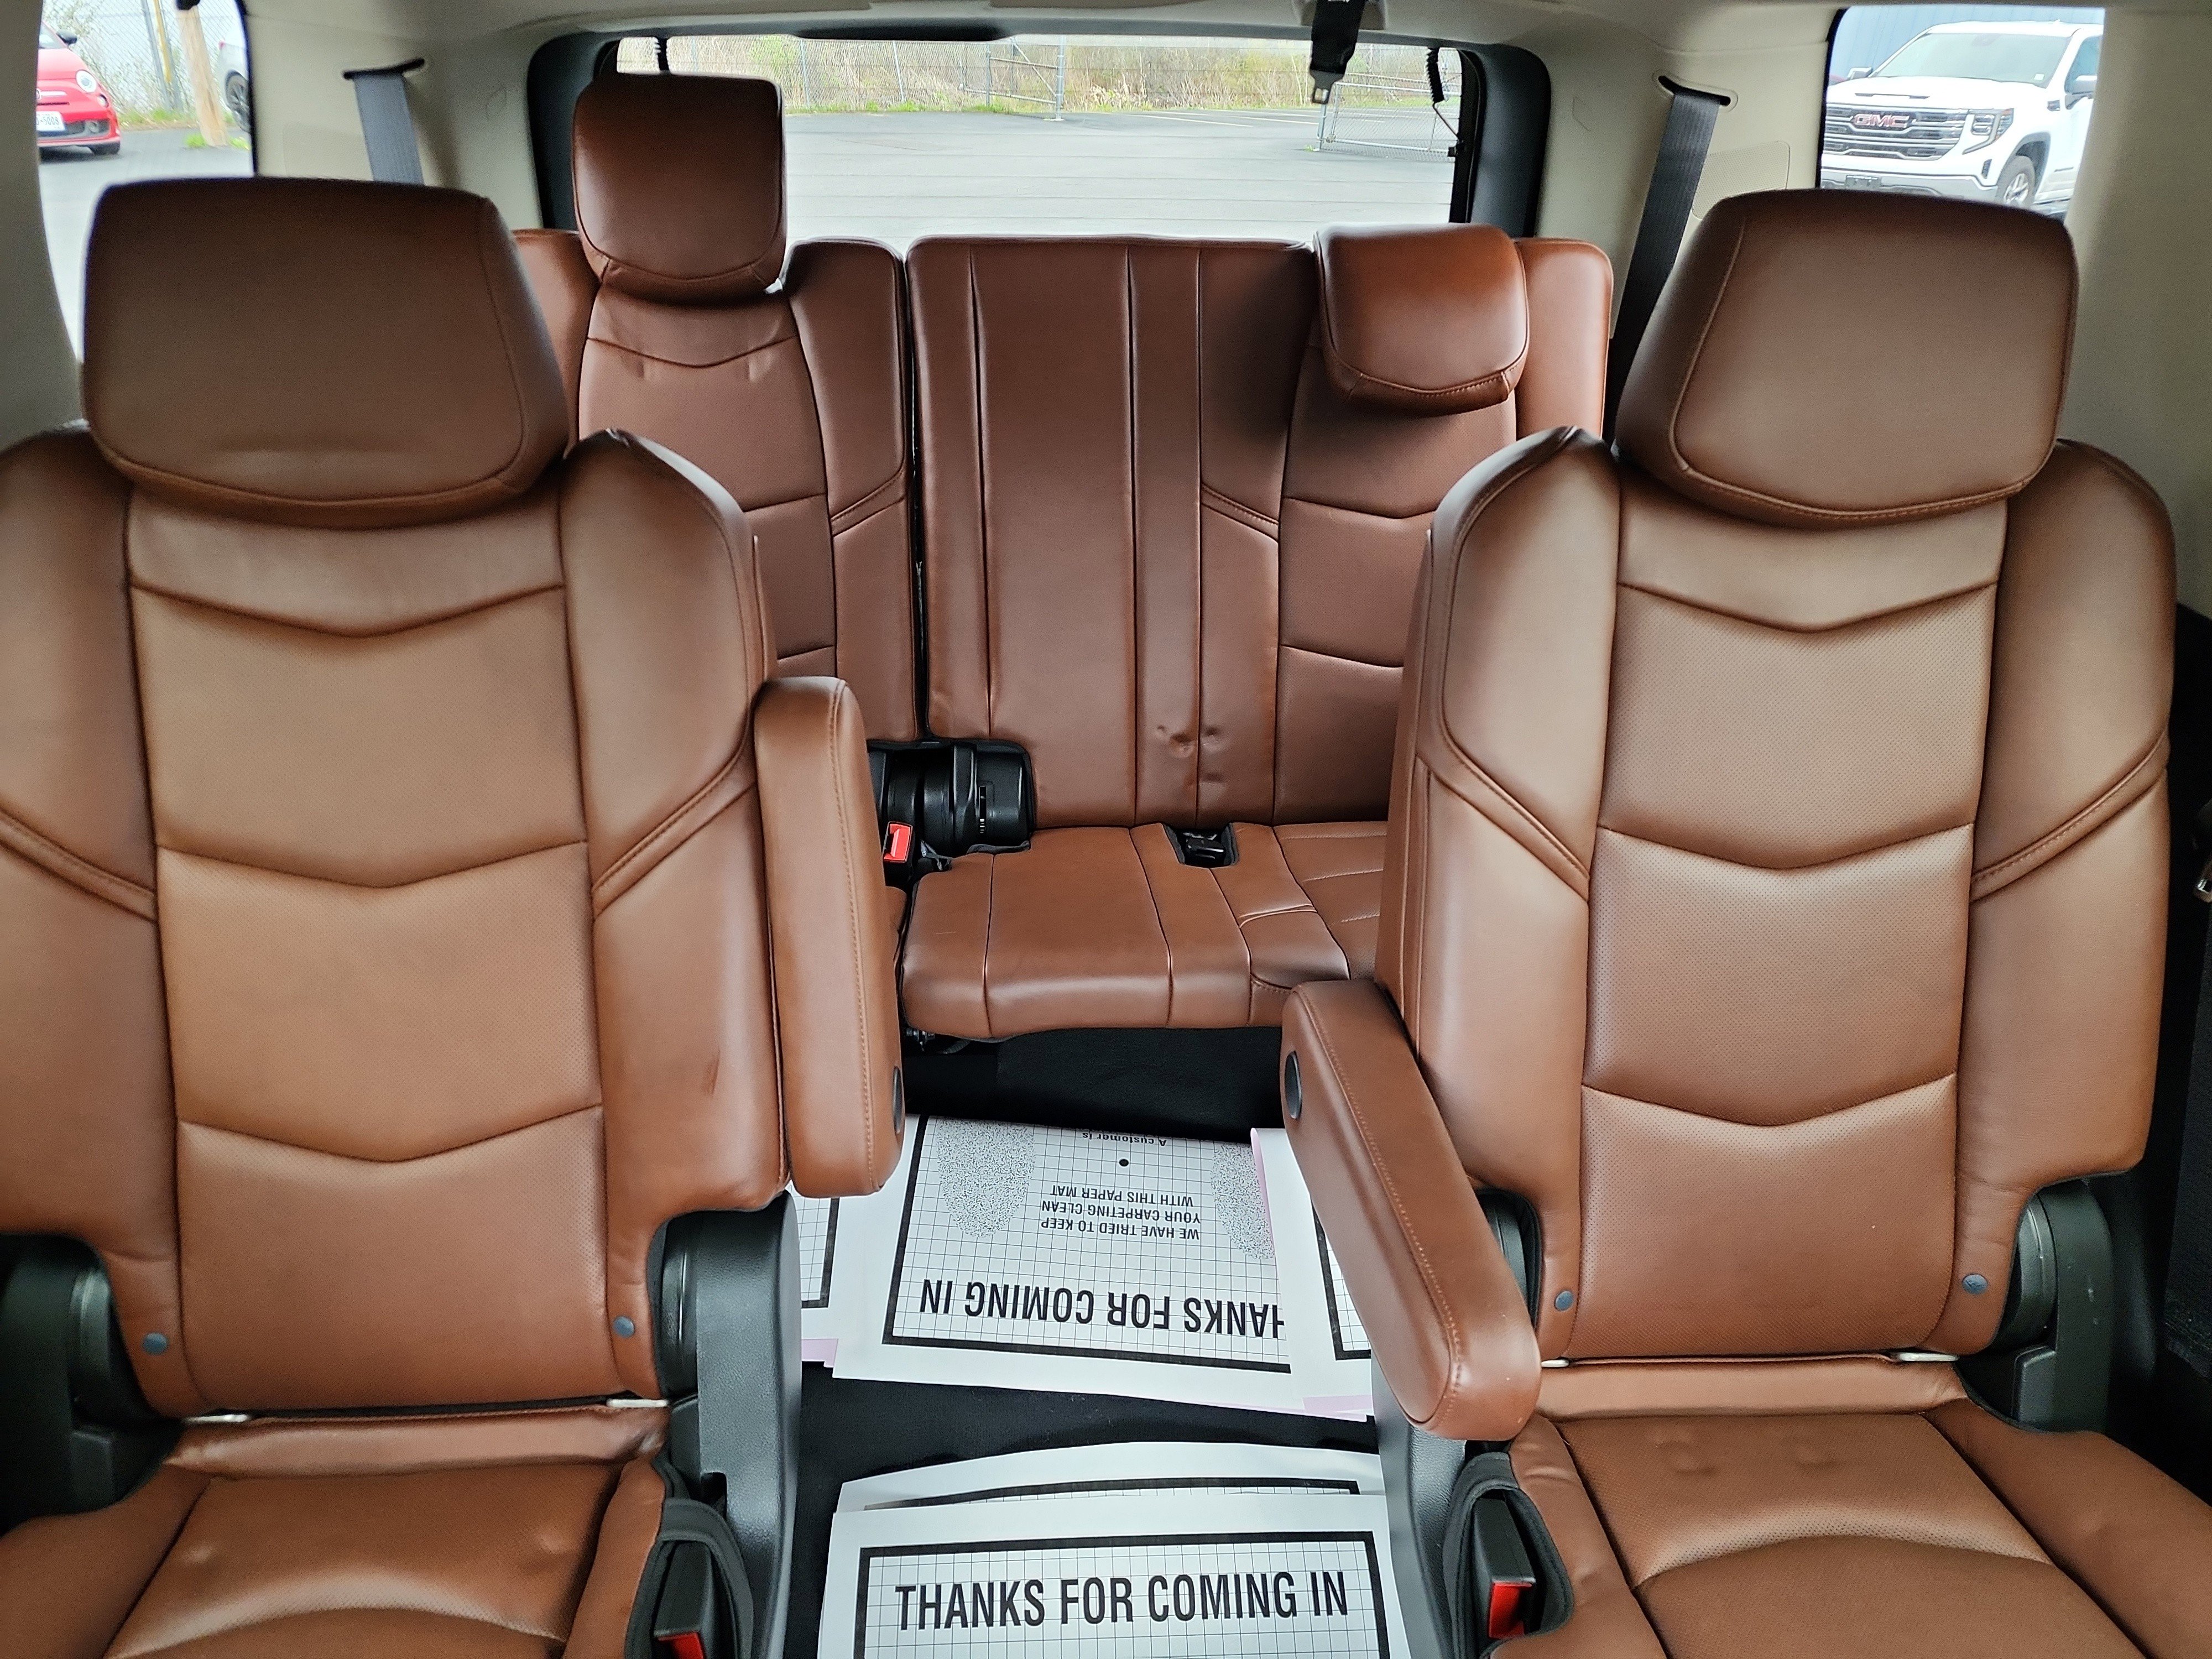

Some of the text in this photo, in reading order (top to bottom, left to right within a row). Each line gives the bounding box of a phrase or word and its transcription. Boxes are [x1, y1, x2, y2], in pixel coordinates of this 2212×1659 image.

[1855, 114, 1910, 128] GMC
[1082, 1131, 1167, 1146] A customer is
[1051, 1185, 1193, 1207] WITH THIS PAPER MAT
[1042, 1201, 1201, 1224] YOUR CARPETING CLEAN
[1041, 1218, 1200, 1240] WE HAVE TRIED TO KEEP
[921, 1279, 952, 1313] IN
[966, 1281, 1095, 1324] COMING
[1107, 1293, 1171, 1329] FOR
[895, 1571, 1349, 1630] THANKS FOR COMING IN
